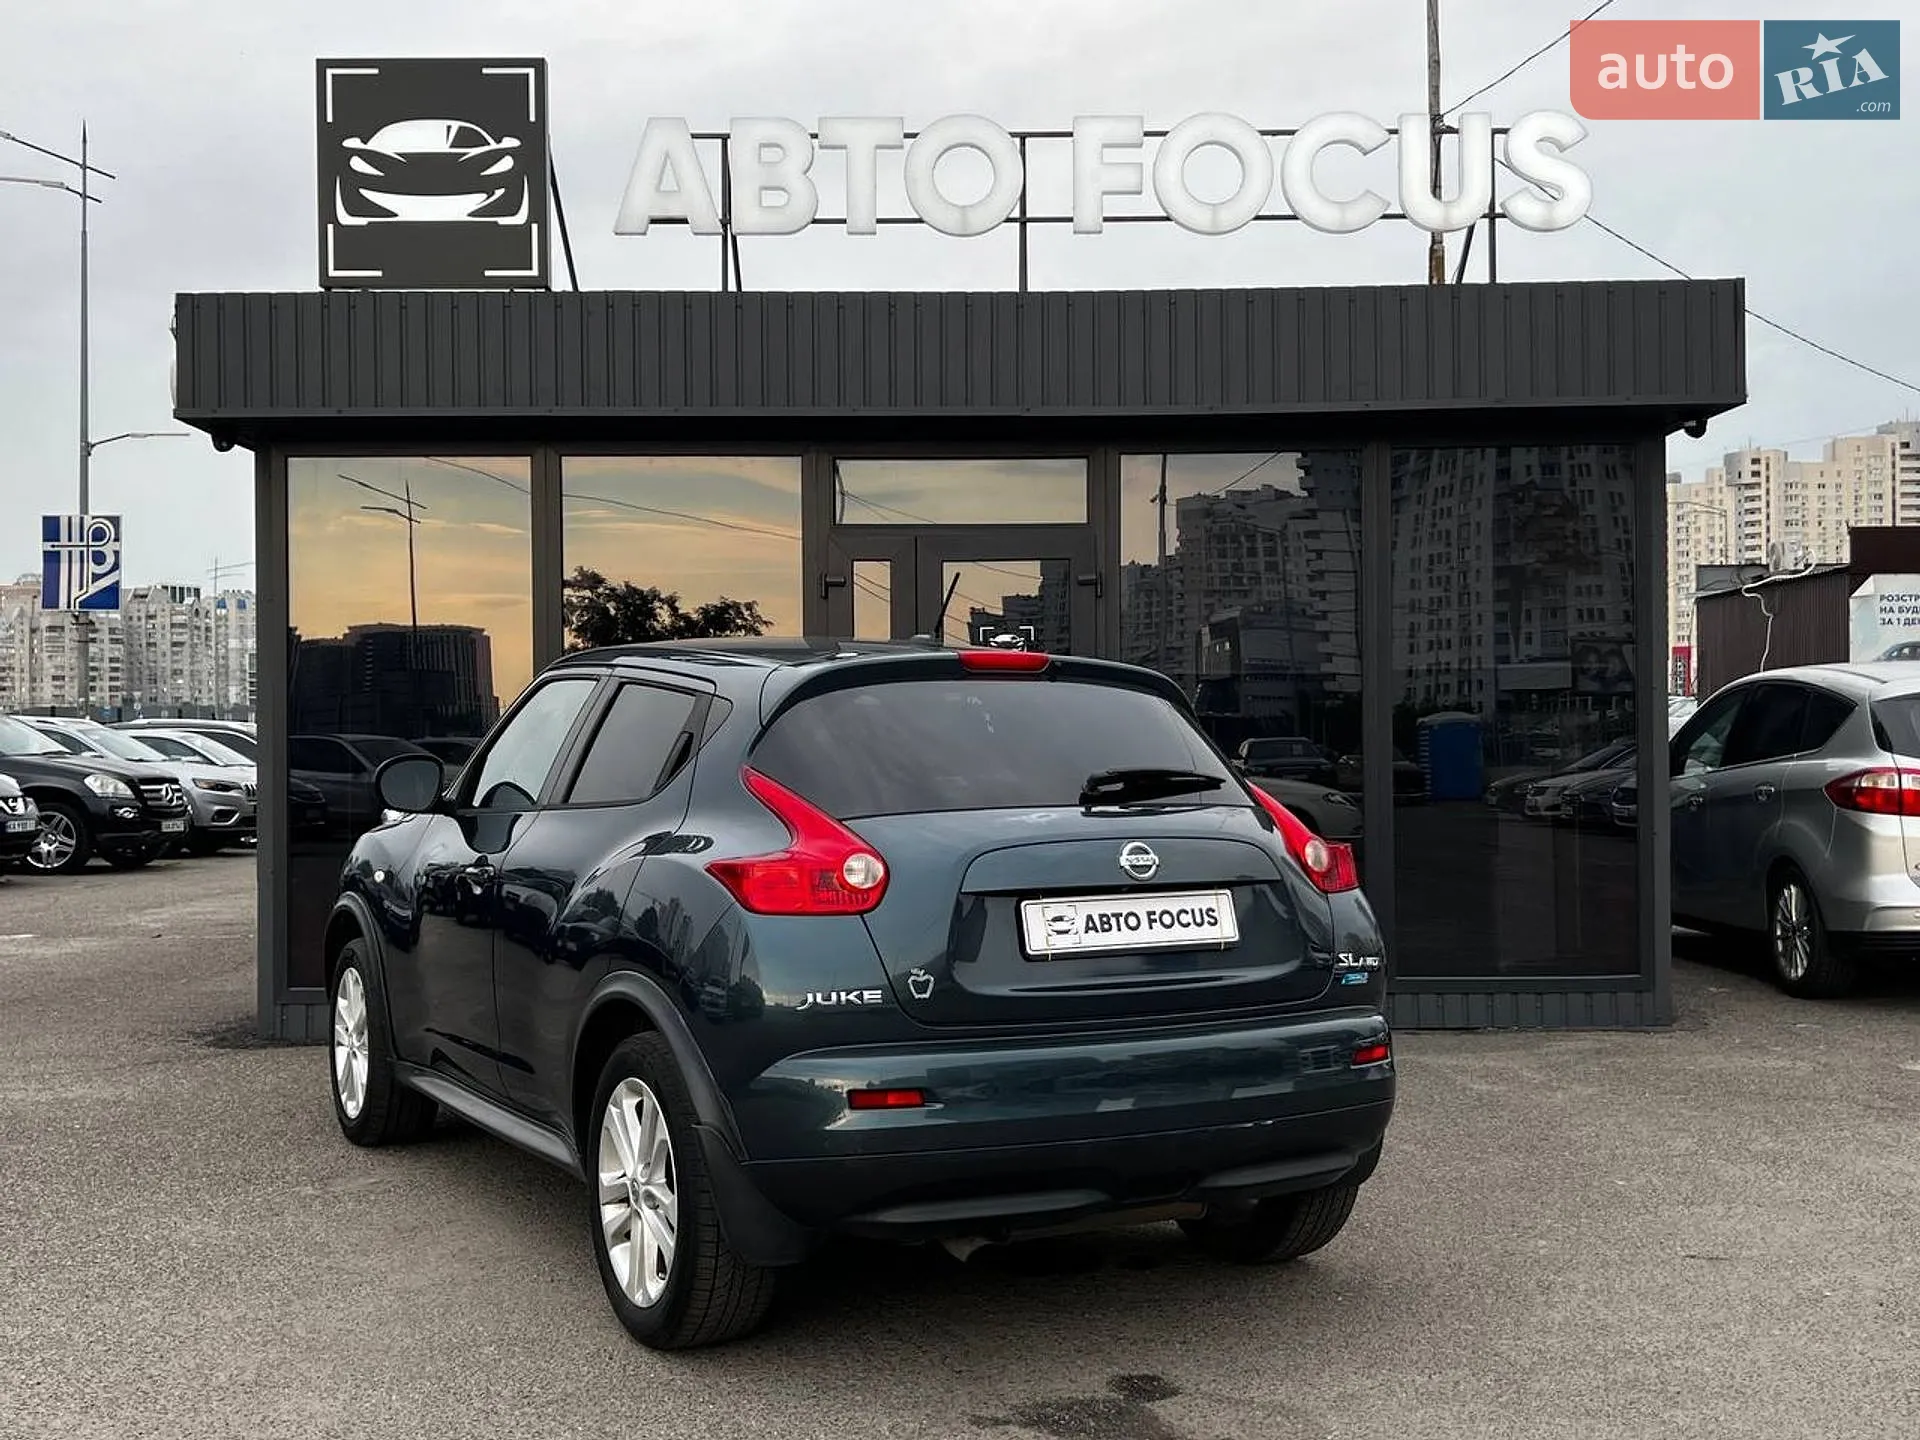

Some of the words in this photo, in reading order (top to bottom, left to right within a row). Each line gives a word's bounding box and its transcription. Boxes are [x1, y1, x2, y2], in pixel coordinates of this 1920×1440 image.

[1072, 110, 1593, 236] FOCUS
[1879, 605, 1895, 614] НА
[1148, 906, 1219, 930] FOCUS
[795, 989, 883, 1011] JUKE
